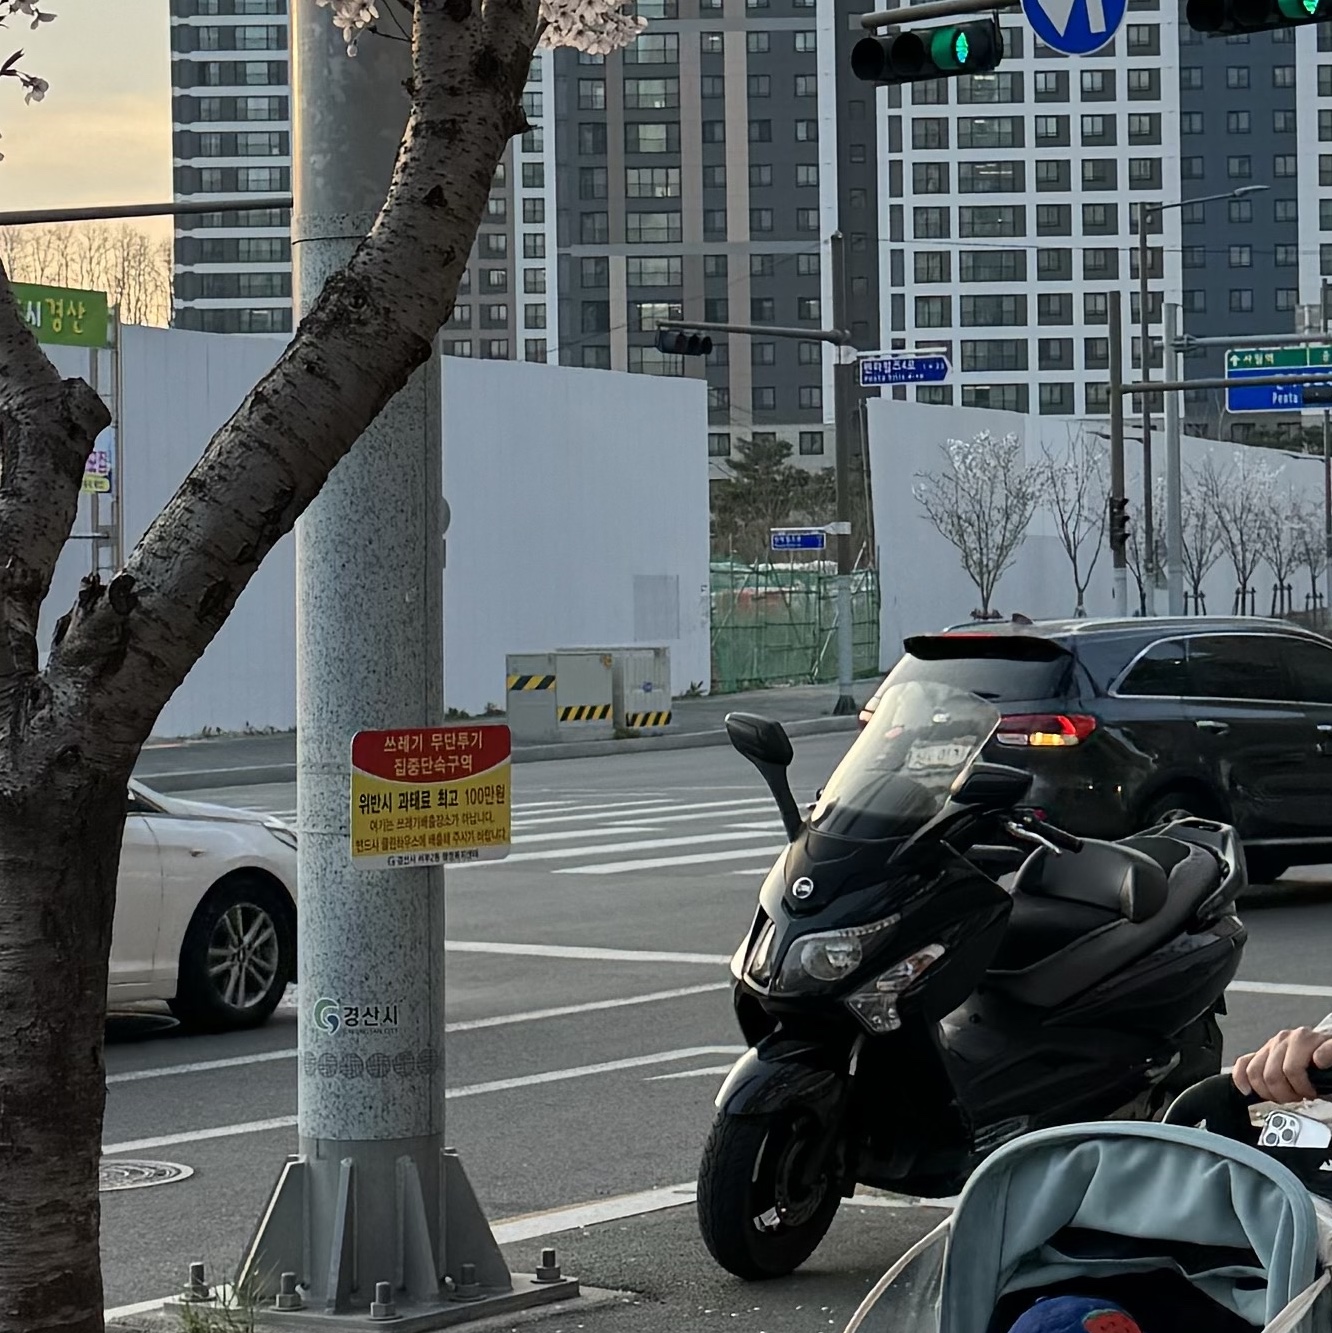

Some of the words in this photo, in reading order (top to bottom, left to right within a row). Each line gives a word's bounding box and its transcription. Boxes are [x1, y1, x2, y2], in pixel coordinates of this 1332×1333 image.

[45, 297, 86, 334] 경산
[1272, 391, 1299, 406] Penta
[384, 733, 423, 752] 쓰레기
[430, 730, 483, 751] 무단투기
[394, 754, 473, 777] 집중단속구역
[358, 792, 393, 815] 위반시
[398, 790, 432, 812] 과태료
[437, 788, 459, 808] 최고
[465, 784, 506, 806] 100만원
[369, 818, 394, 833] 여기는
[396, 814, 460, 832] 쓰레기배출장소가
[355, 839, 380, 853] 반드시
[343, 1005, 398, 1027] 경산시
